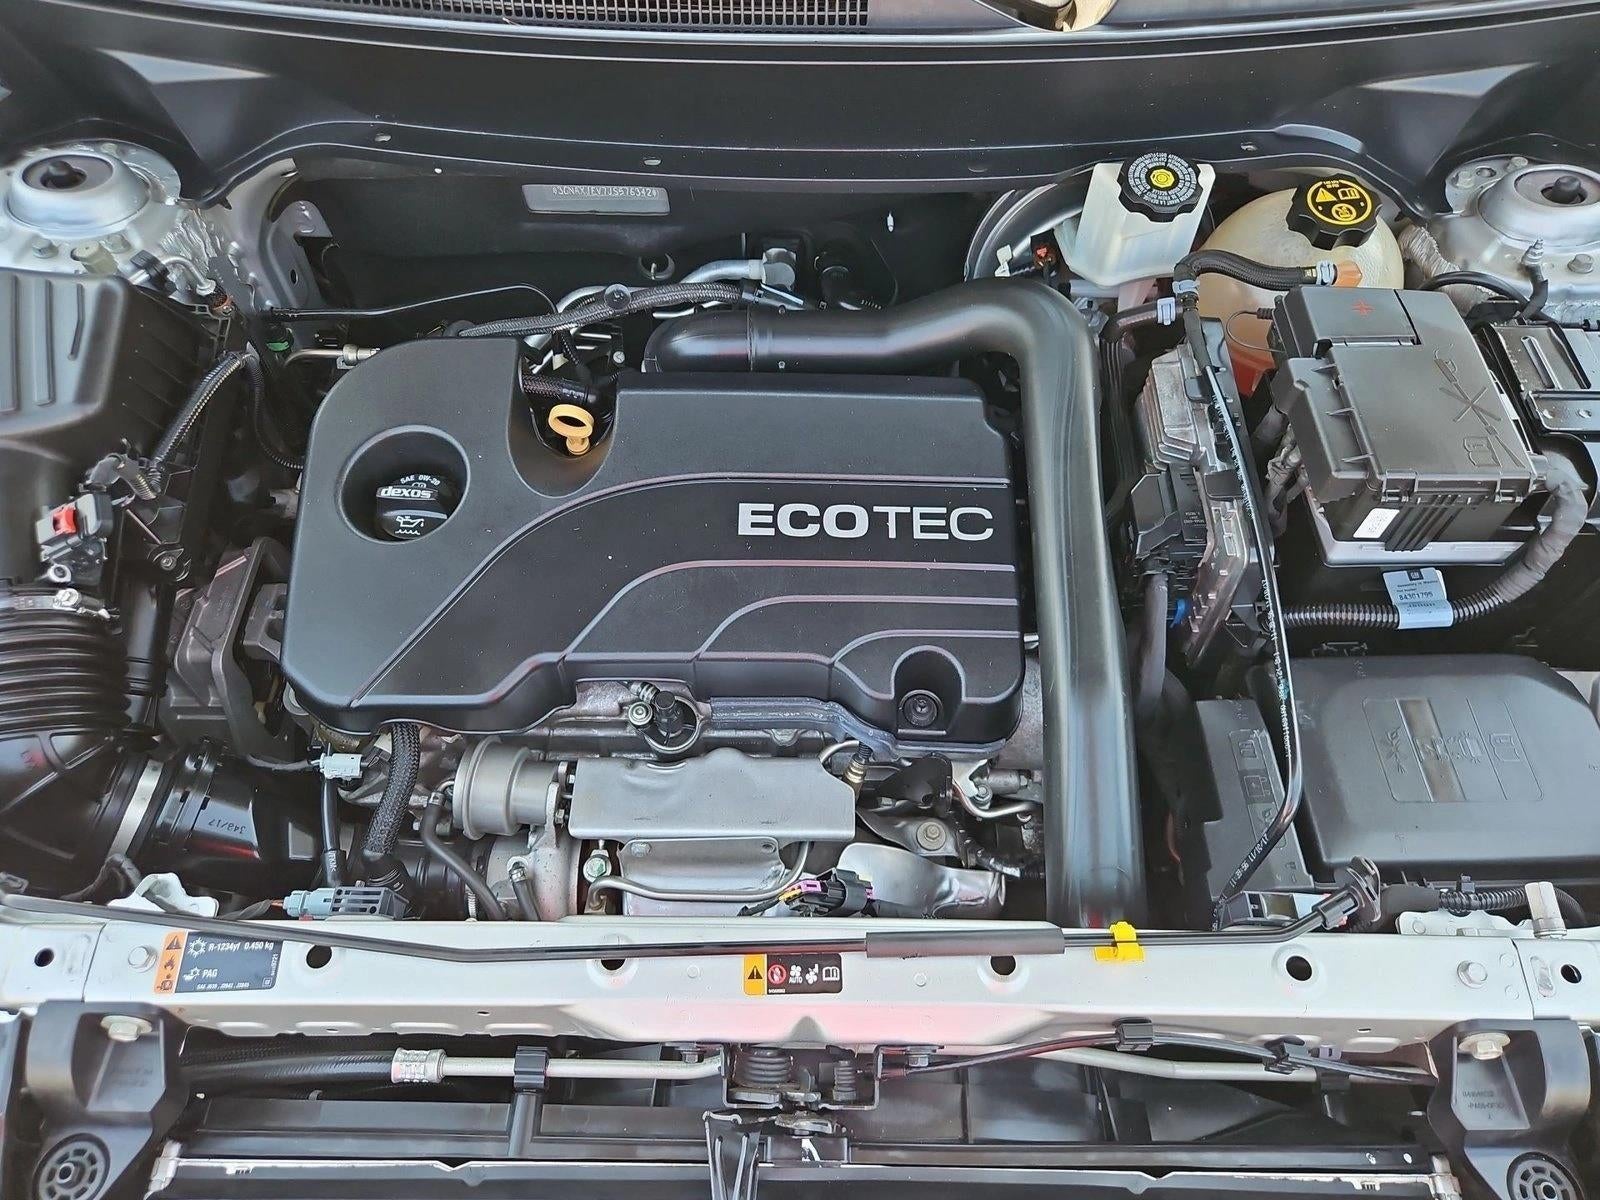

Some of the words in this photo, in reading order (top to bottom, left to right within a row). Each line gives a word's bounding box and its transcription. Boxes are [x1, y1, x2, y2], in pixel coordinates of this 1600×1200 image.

[400, 474, 415, 484] SAE
[418, 474, 441, 486] 0W-20
[380, 486, 432, 499] dexos
[738, 503, 994, 541] ECOTEC
[264, 942, 274, 951] kg
[202, 968, 218, 978] PAG
[789, 976, 803, 984] AUTO
